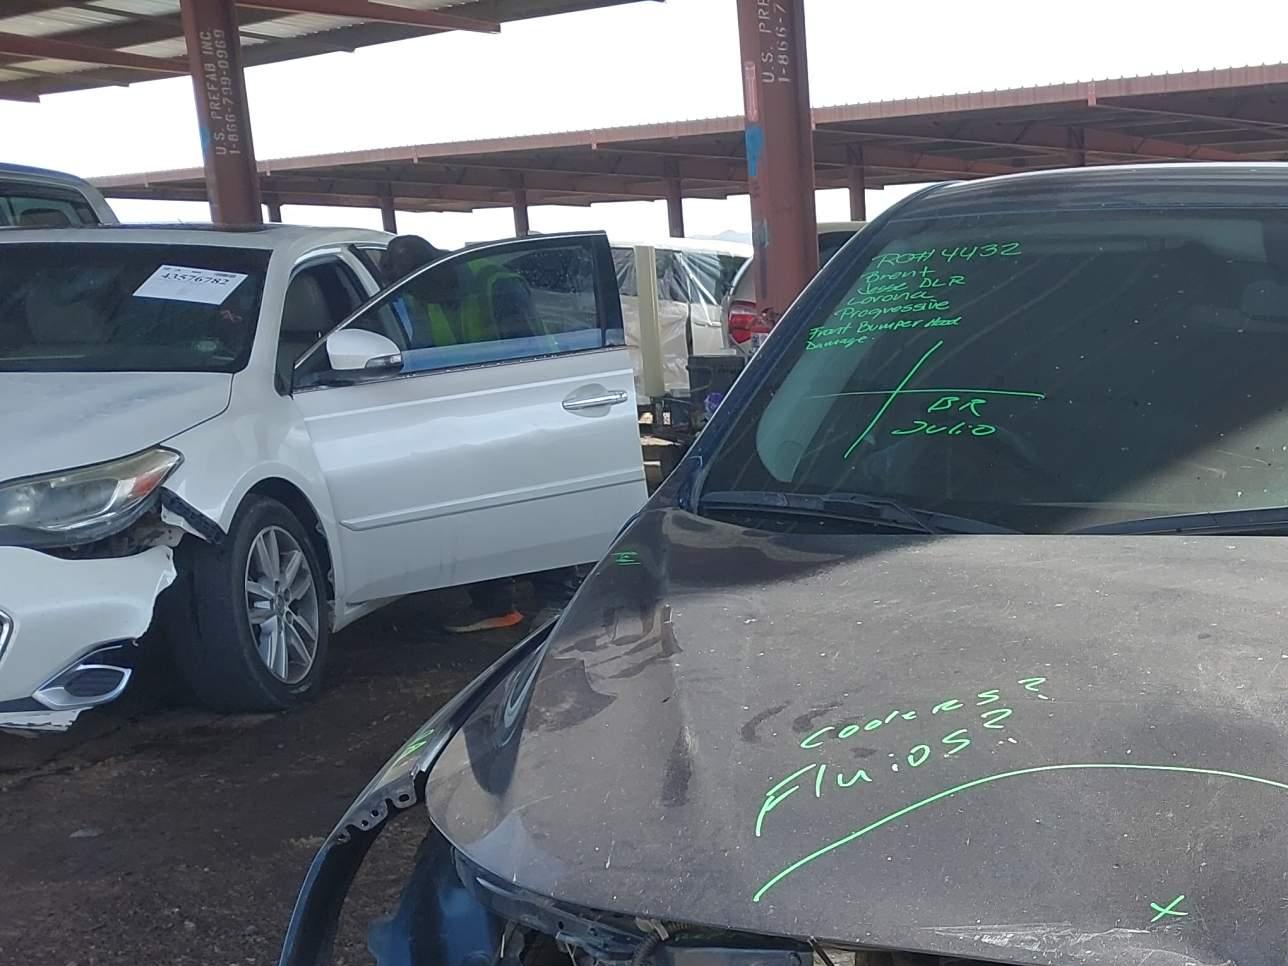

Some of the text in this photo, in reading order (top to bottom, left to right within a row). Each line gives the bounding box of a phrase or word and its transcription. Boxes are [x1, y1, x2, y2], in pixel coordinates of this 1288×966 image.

[203, 63, 223, 120] PREFAB
[941, 242, 1022, 262] 4432
[860, 266, 935, 283] Brent
[919, 275, 966, 288] DLR
[834, 300, 949, 321] Progressive
[809, 322, 852, 340] Front
[927, 396, 987, 417] BR
